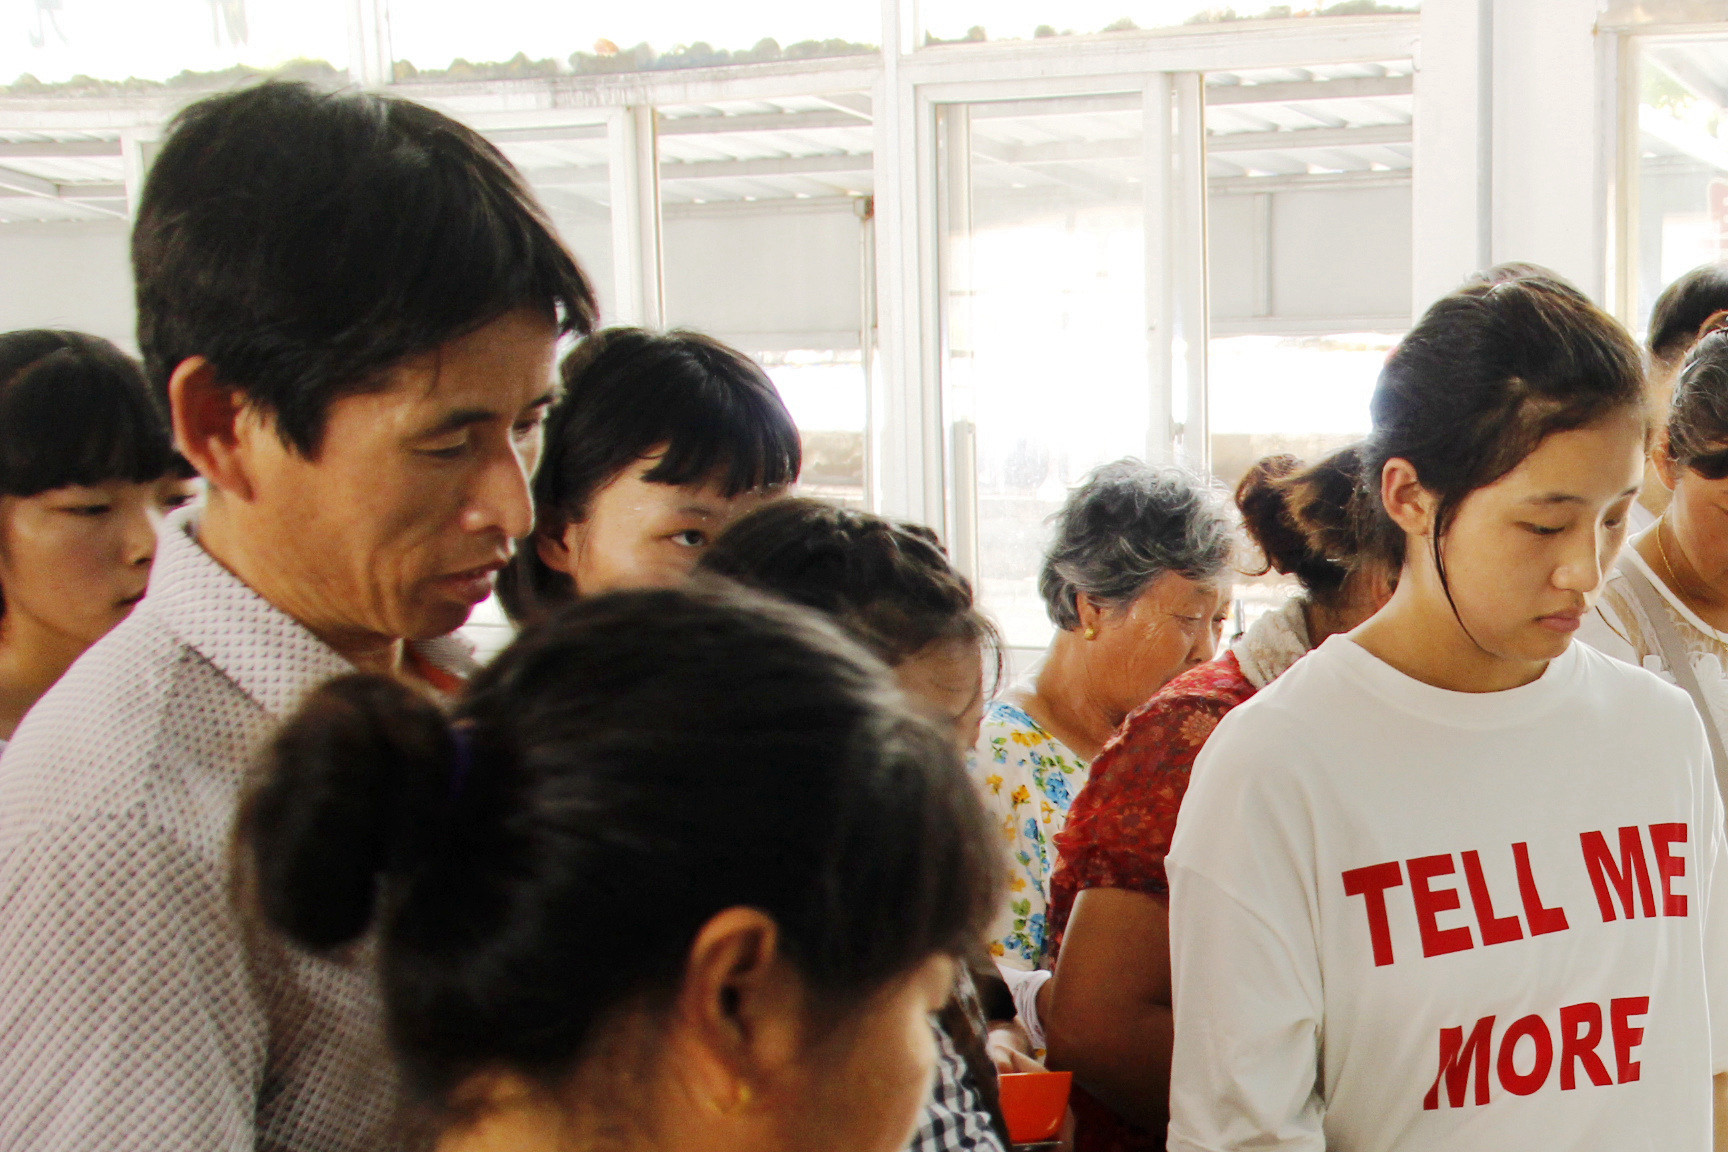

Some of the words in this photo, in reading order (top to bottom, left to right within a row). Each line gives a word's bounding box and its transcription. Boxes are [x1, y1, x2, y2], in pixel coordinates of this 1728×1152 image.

[1342, 841, 1569, 966] TELL
[1580, 822, 1688, 922] ME
[1423, 996, 1650, 1110] MORE
